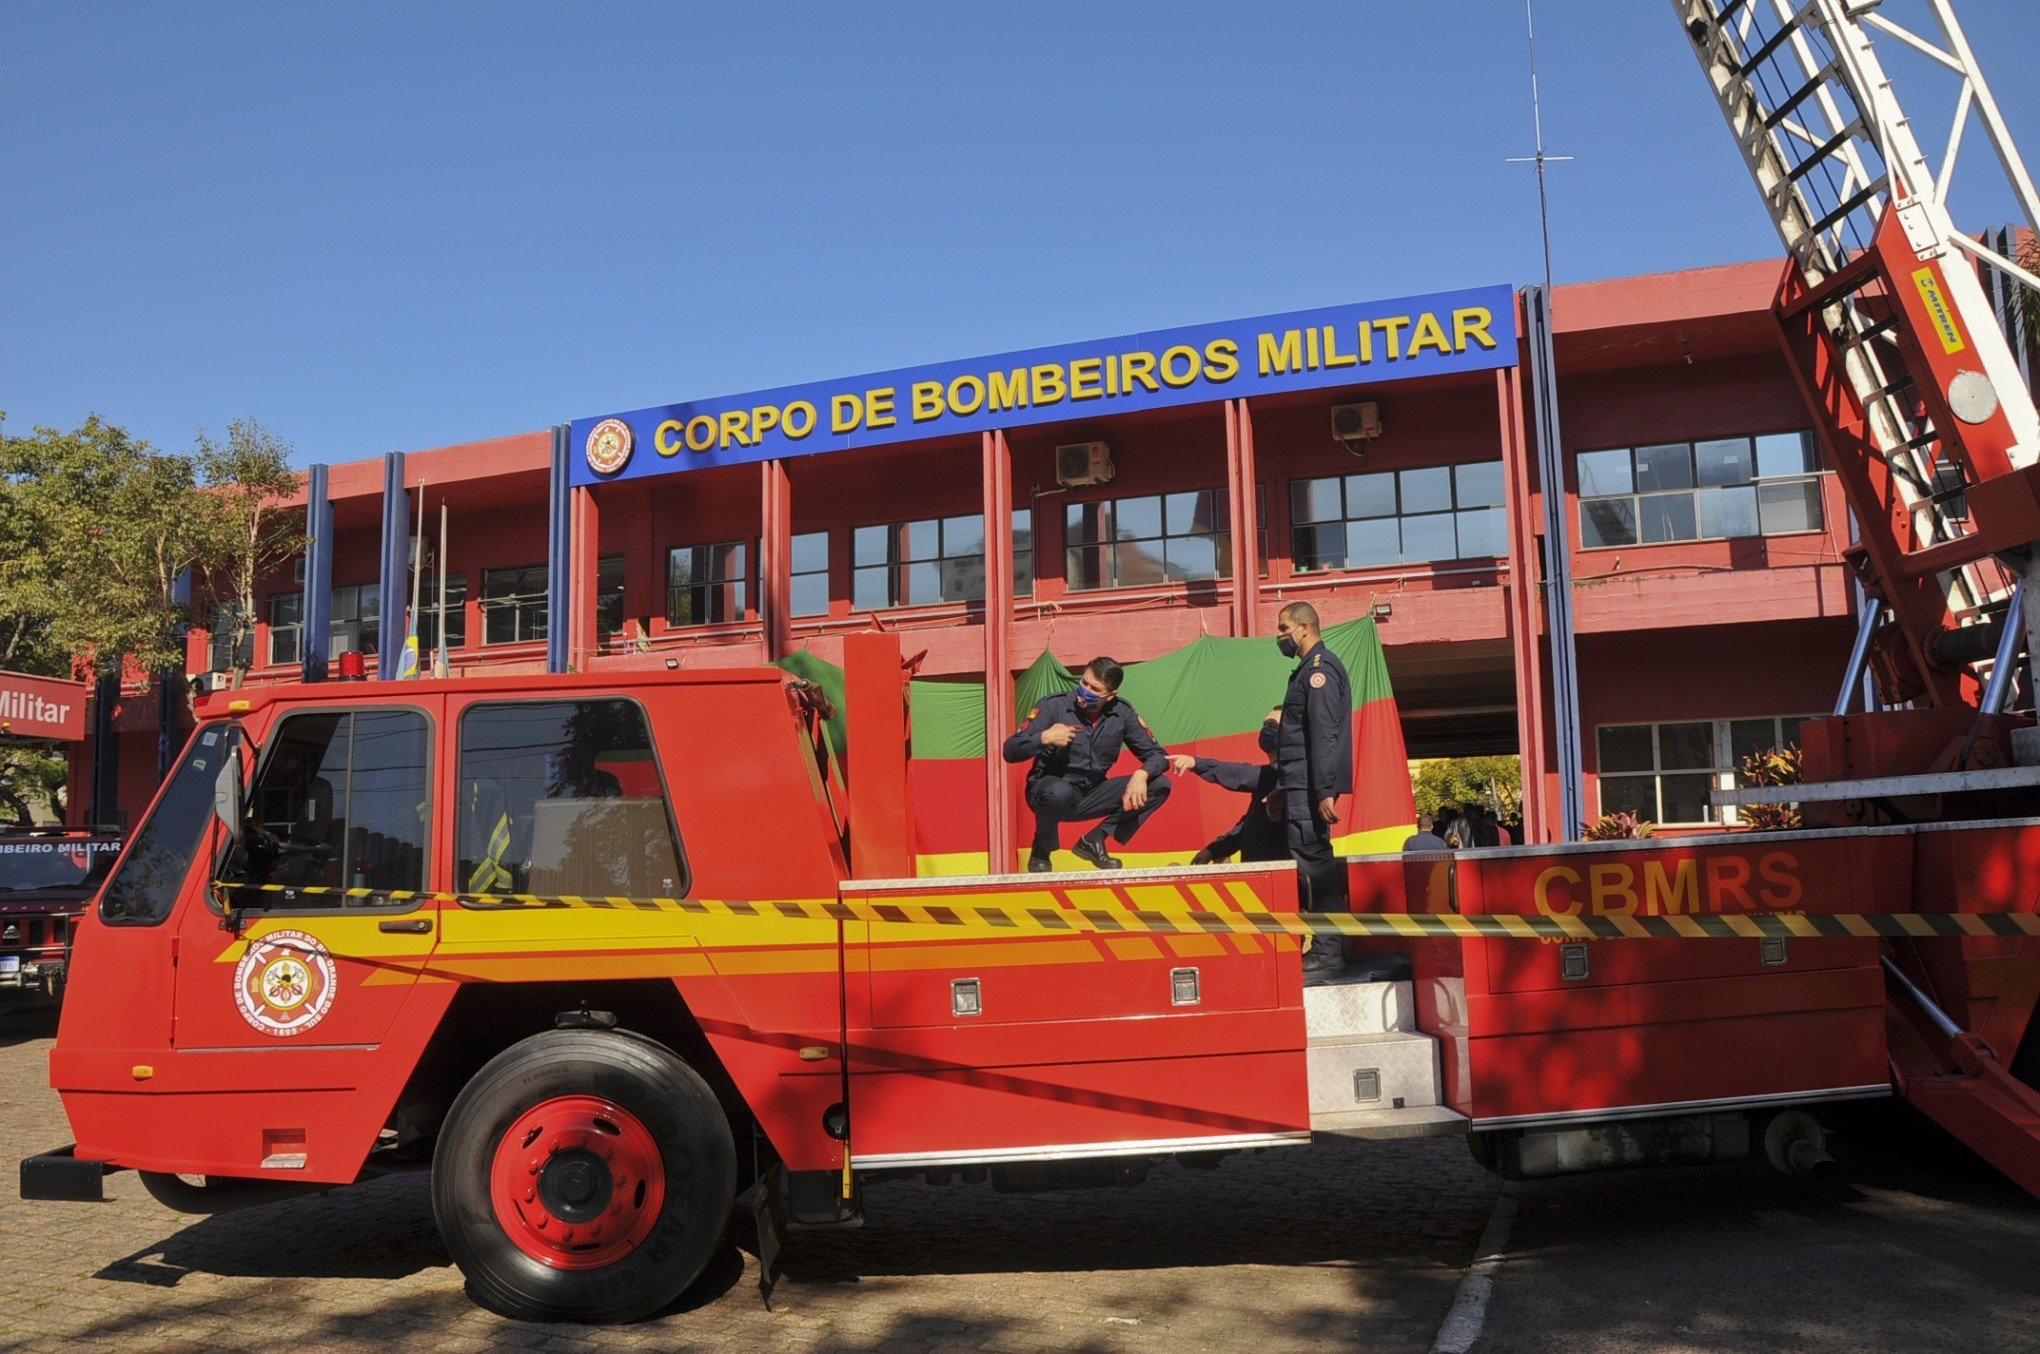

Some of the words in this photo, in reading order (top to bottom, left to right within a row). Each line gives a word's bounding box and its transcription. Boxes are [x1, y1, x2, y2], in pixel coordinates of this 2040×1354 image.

[1927, 289, 1957, 343] MITREN
[654, 401, 817, 458] CORPO
[832, 388, 896, 434] DE
[912, 338, 1240, 422] BOMBEIROS
[1258, 307, 1497, 376] MILITAR
[57, 842, 121, 853] MILITAR
[1533, 851, 1803, 917] CBMRS
